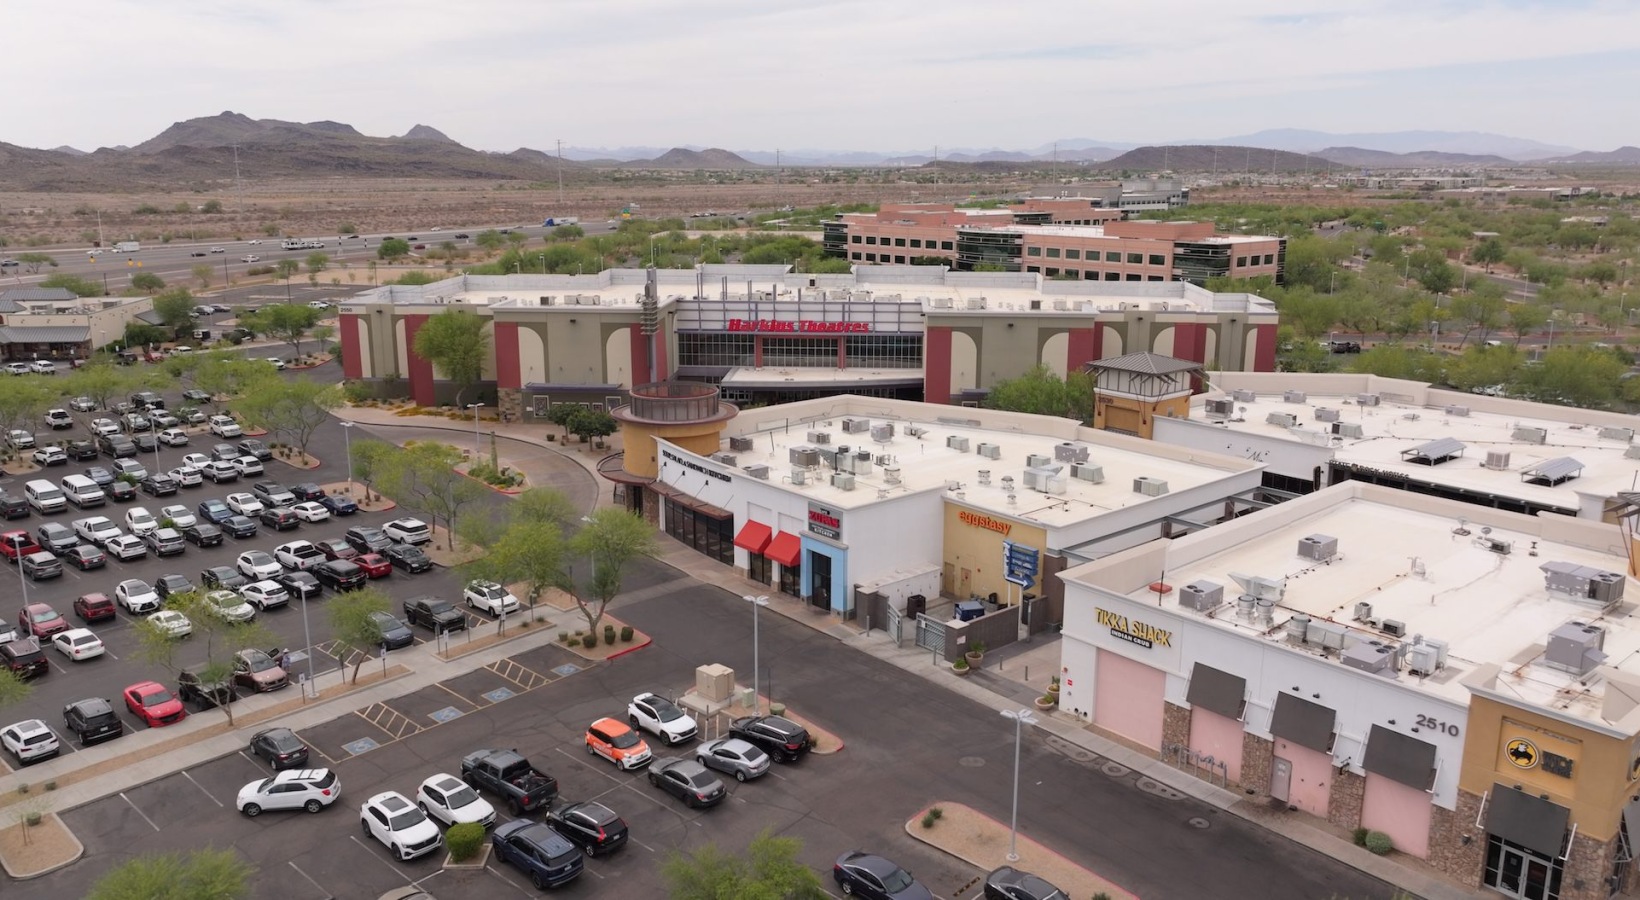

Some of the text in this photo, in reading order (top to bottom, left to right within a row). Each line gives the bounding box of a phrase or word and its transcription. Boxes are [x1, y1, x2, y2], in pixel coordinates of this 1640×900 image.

[728, 318, 869, 333] Harkins Theatres
[958, 510, 1012, 536] eggstasy
[1094, 606, 1172, 648] TIKKA SHACK
[1111, 629, 1133, 642] INDIAN
[1415, 713, 1460, 737] 2510
